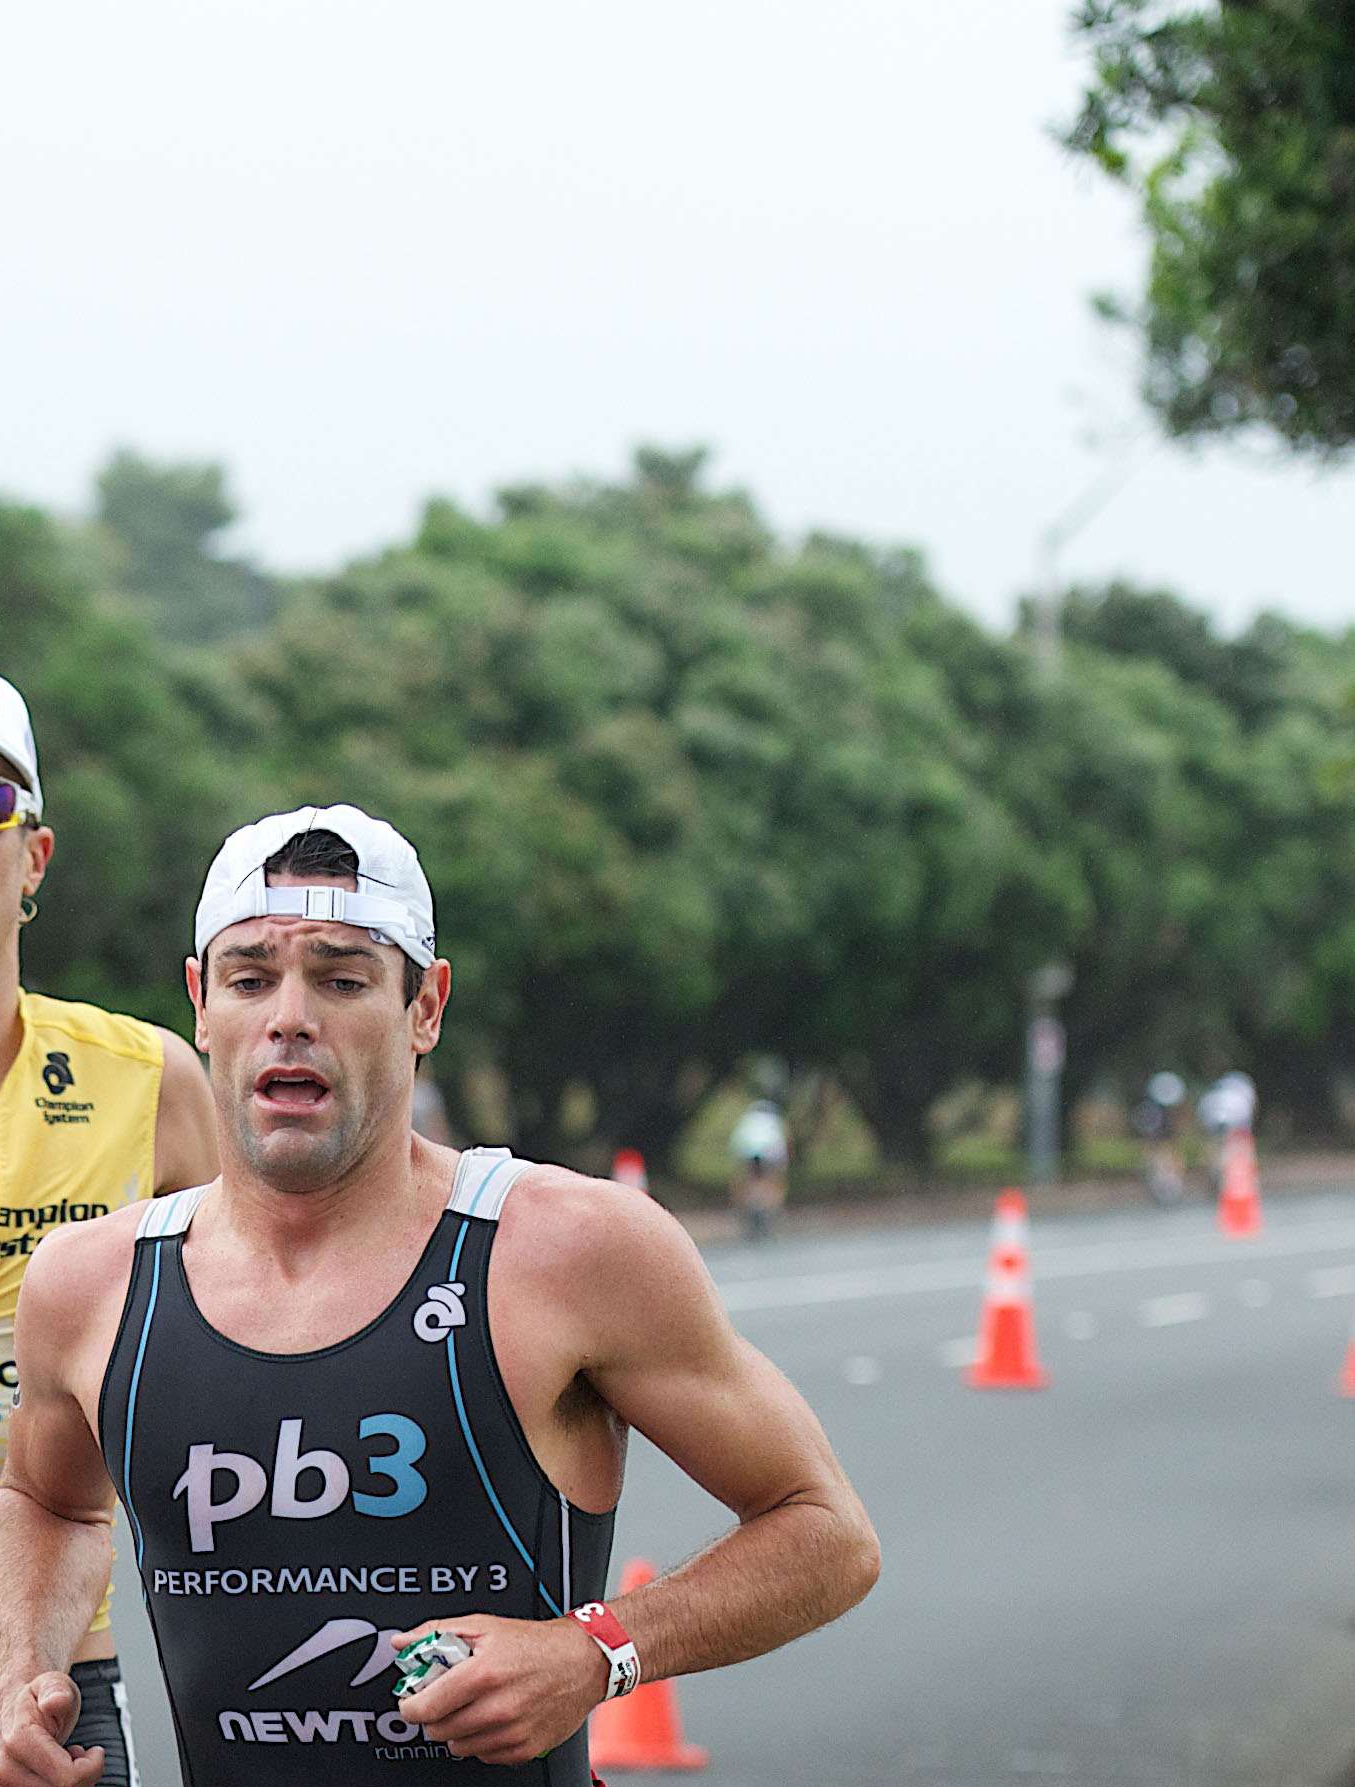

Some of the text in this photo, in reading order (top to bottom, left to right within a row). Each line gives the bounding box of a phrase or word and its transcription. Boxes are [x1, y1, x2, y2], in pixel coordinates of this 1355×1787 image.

[172, 1413, 428, 1553] pb3
[153, 1564, 508, 1596] PERFORMANCE BY 3
